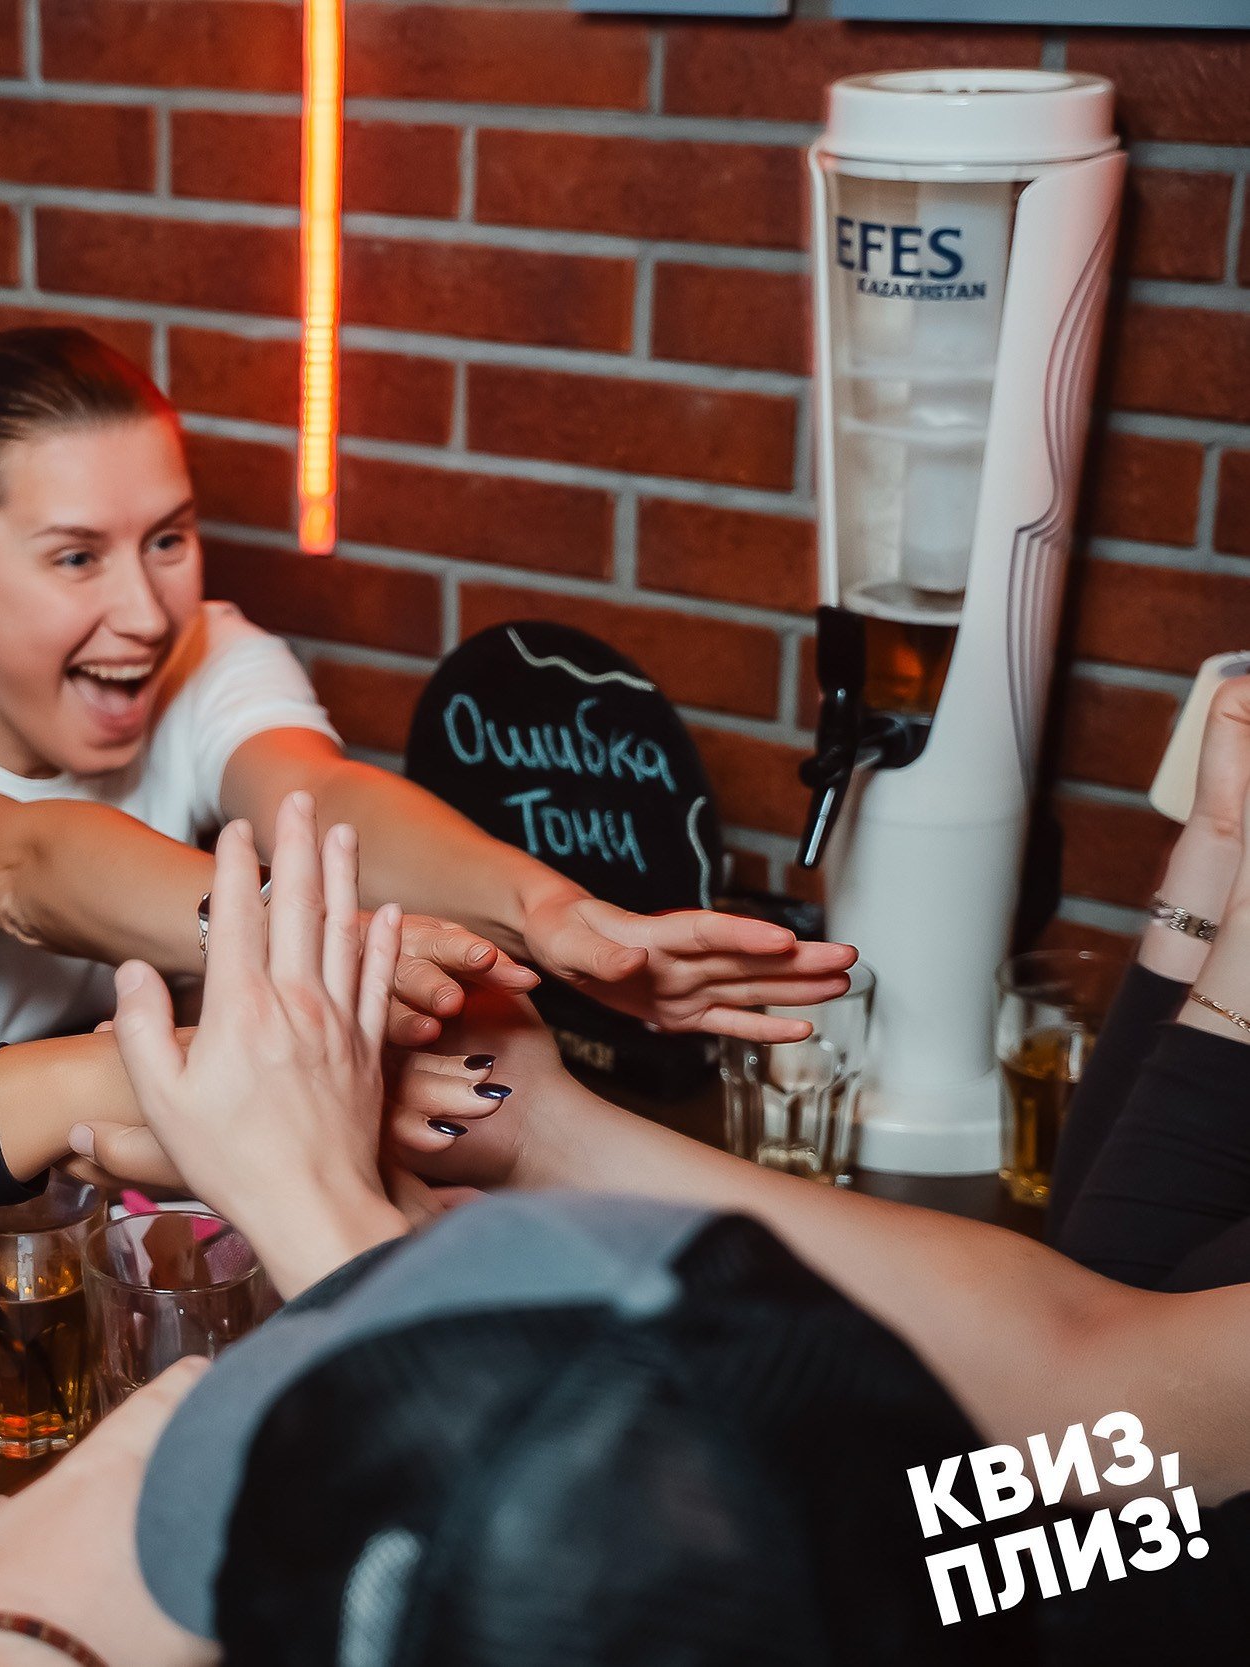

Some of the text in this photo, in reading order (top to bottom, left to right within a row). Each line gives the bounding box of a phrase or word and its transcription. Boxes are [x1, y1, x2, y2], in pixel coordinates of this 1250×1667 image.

[836, 215, 964, 280] EFES
[857, 278, 987, 299] KAZAKHSTAN
[443, 693, 676, 793] Ошибка
[503, 788, 648, 873] Тони
